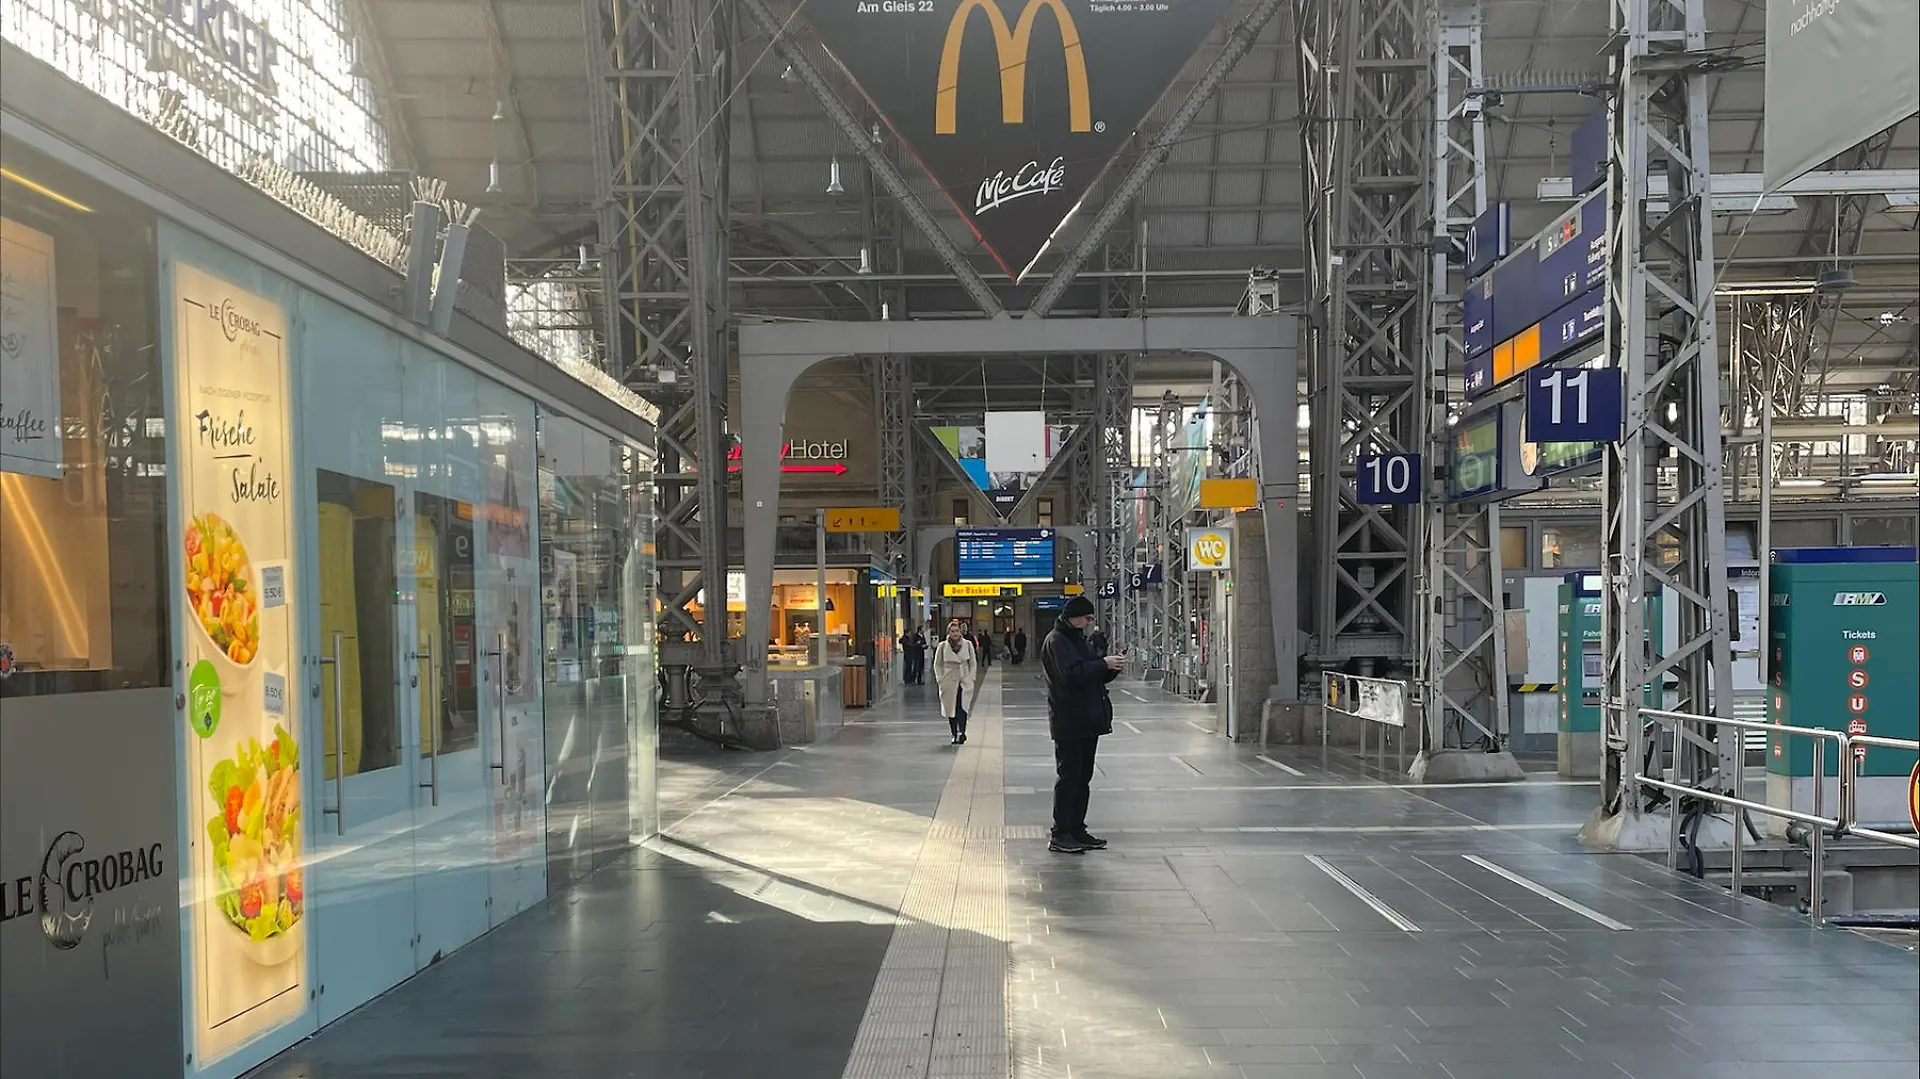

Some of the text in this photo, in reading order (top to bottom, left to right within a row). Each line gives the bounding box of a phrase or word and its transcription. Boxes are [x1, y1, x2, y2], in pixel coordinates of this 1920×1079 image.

[857, 0, 934, 13] Am Gleis 22
[976, 156, 1065, 210] McCafé
[1465, 226, 1477, 265] 10
[209, 304, 260, 337] LE CROBAG
[1540, 371, 1588, 424] 11
[195, 408, 256, 450] Frische
[231, 462, 280, 504] Salate
[1366, 455, 1410, 494] 10
[1197, 540, 1222, 559] WC
[1131, 574, 1141, 587] 6
[1146, 564, 1155, 579] 7
[1106, 582, 1115, 595] 5
[1842, 630, 1876, 639] Tickets
[1851, 673, 1864, 687] S
[1852, 698, 1864, 711] U
[0, 843, 163, 922] LE CROBAG
